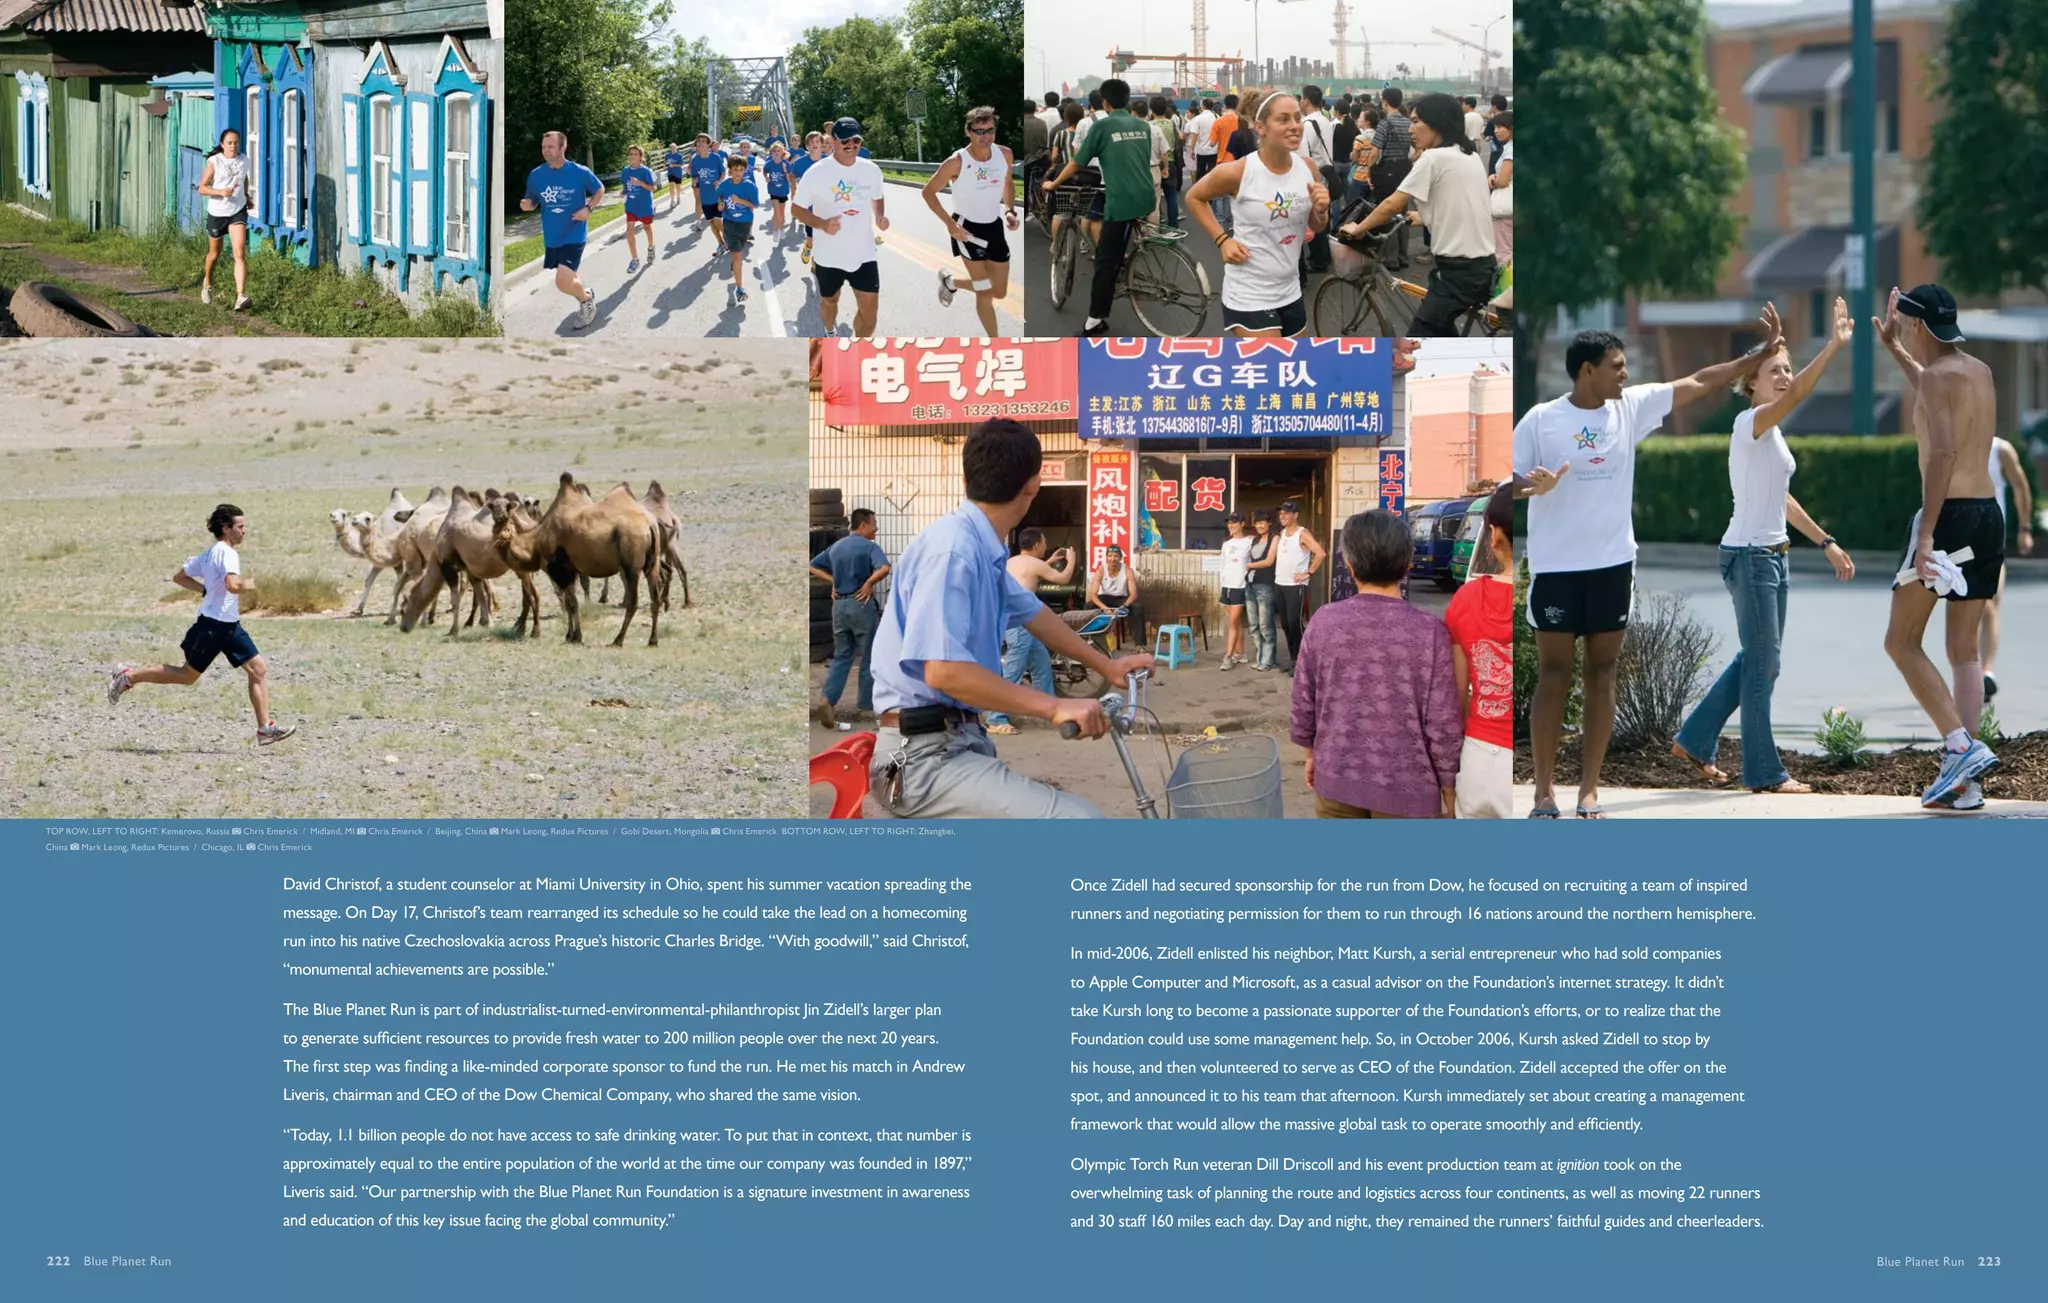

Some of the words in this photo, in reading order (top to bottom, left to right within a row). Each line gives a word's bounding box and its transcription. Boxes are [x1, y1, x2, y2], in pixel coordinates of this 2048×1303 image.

[861, 348, 1027, 403] 电气焊
[1147, 360, 1318, 390] 辽G车队
[962, 400, 1070, 417] 13231353246
[1152, 394, 1177, 411] 浙江
[1187, 394, 1212, 411] 山东
[1221, 393, 1246, 411] 大连
[1256, 392, 1281, 410] 上海
[1291, 392, 1317, 410] 南昌
[1327, 390, 1380, 410] 广州等地
[1380, 453, 1403, 516] 北宁
[1144, 476, 1227, 512] 配货
[284, 878, 320, 890] David
[325, 877, 382, 892] Christof,
[386, 881, 393, 890] a
[398, 878, 447, 890] student
[451, 878, 515, 890] counselor
[520, 880, 532, 890] at
[536, 878, 574, 890] Miami
[580, 878, 646, 894] University
[650, 878, 661, 890] in
[666, 877, 702, 891] Ohio,
[708, 881, 743, 894] spent
[748, 878, 764, 890] his
[769, 881, 822, 890] summer
[827, 878, 880, 890] vacation
[885, 878, 946, 894] spreading
[950, 878, 971, 890] the
[1072, 947, 1082, 959] In
[1088, 946, 1152, 961] mid-2006,
[1157, 947, 1193, 959] Zidell
[1198, 947, 1248, 959] enlisted
[1253, 947, 1270, 959] his
[1275, 947, 1333, 963] neighbor,
[1339, 947, 1369, 959] Matt
[1374, 947, 1415, 961] Kursh,
[1420, 950, 1427, 959] a
[1431, 947, 1464, 959] serial
[1470, 950, 1557, 963] entrepreneur
[1561, 947, 1590, 959] who
[1595, 947, 1617, 959] had
[1622, 947, 1648, 959] sold
[1653, 948, 1721, 963] companies
[283, 963, 371, 975] “monumental
[376, 963, 463, 975] achievements
[468, 966, 488, 975] are
[493, 962, 554, 979] possible.”
[283, 1003, 308, 1016] The
[314, 1003, 342, 1016] Blue
[347, 1003, 386, 1016] Planet
[391, 1003, 415, 1015] Run
[420, 1004, 429, 1016] is
[434, 1006, 462, 1019] part
[466, 1003, 479, 1016] of
[483, 1003, 800, 1019] industrialist-turned-environmental-philanthropist
[803, 1003, 819, 1019] Jin
[824, 1003, 868, 1016] Zidell’s
[874, 1003, 911, 1019] larger
[916, 1003, 941, 1019] plan
[284, 1088, 328, 1102] Liveris,
[333, 1088, 392, 1101] chairman
[397, 1088, 419, 1100] and
[424, 1088, 457, 1101] CEO
[462, 1088, 476, 1101] of
[479, 1088, 500, 1101] the
[505, 1088, 537, 1101] Dow
[542, 1088, 602, 1101] Chemical
[607, 1088, 672, 1104] Company,
[676, 1088, 705, 1100] who
[710, 1088, 752, 1101] shared
[757, 1088, 778, 1100] the
[783, 1092, 816, 1101] same
[820, 1089, 860, 1101] vision.
[1071, 1214, 1093, 1227] and
[1099, 1214, 1114, 1227] 30
[1119, 1214, 1147, 1227] staff
[1153, 1214, 1173, 1227] 160
[1178, 1215, 1210, 1227] miles
[1215, 1215, 1244, 1227] each
[1250, 1215, 1273, 1231] day.
[1279, 1215, 1304, 1231] Day
[1308, 1215, 1331, 1227] and
[1336, 1215, 1371, 1231] night,
[1376, 1215, 1404, 1231] they
[1409, 1215, 1468, 1227] remained
[1473, 1215, 1494, 1227] the
[1500, 1214, 1552, 1227] runners’
[1557, 1214, 1600, 1227] faithful
[1604, 1215, 1645, 1231] guides
[1650, 1214, 1672, 1227] and
[1677, 1215, 1764, 1227] cheerleaders.
[47, 1256, 70, 1266] 222
[84, 1256, 108, 1266] Blue
[112, 1256, 146, 1266] Planet
[151, 1256, 171, 1266] Run
[1877, 1257, 1900, 1266] Blue
[1906, 1256, 1939, 1266] Planet
[1944, 1256, 1964, 1266] Run
[1978, 1256, 2000, 1266] 223
